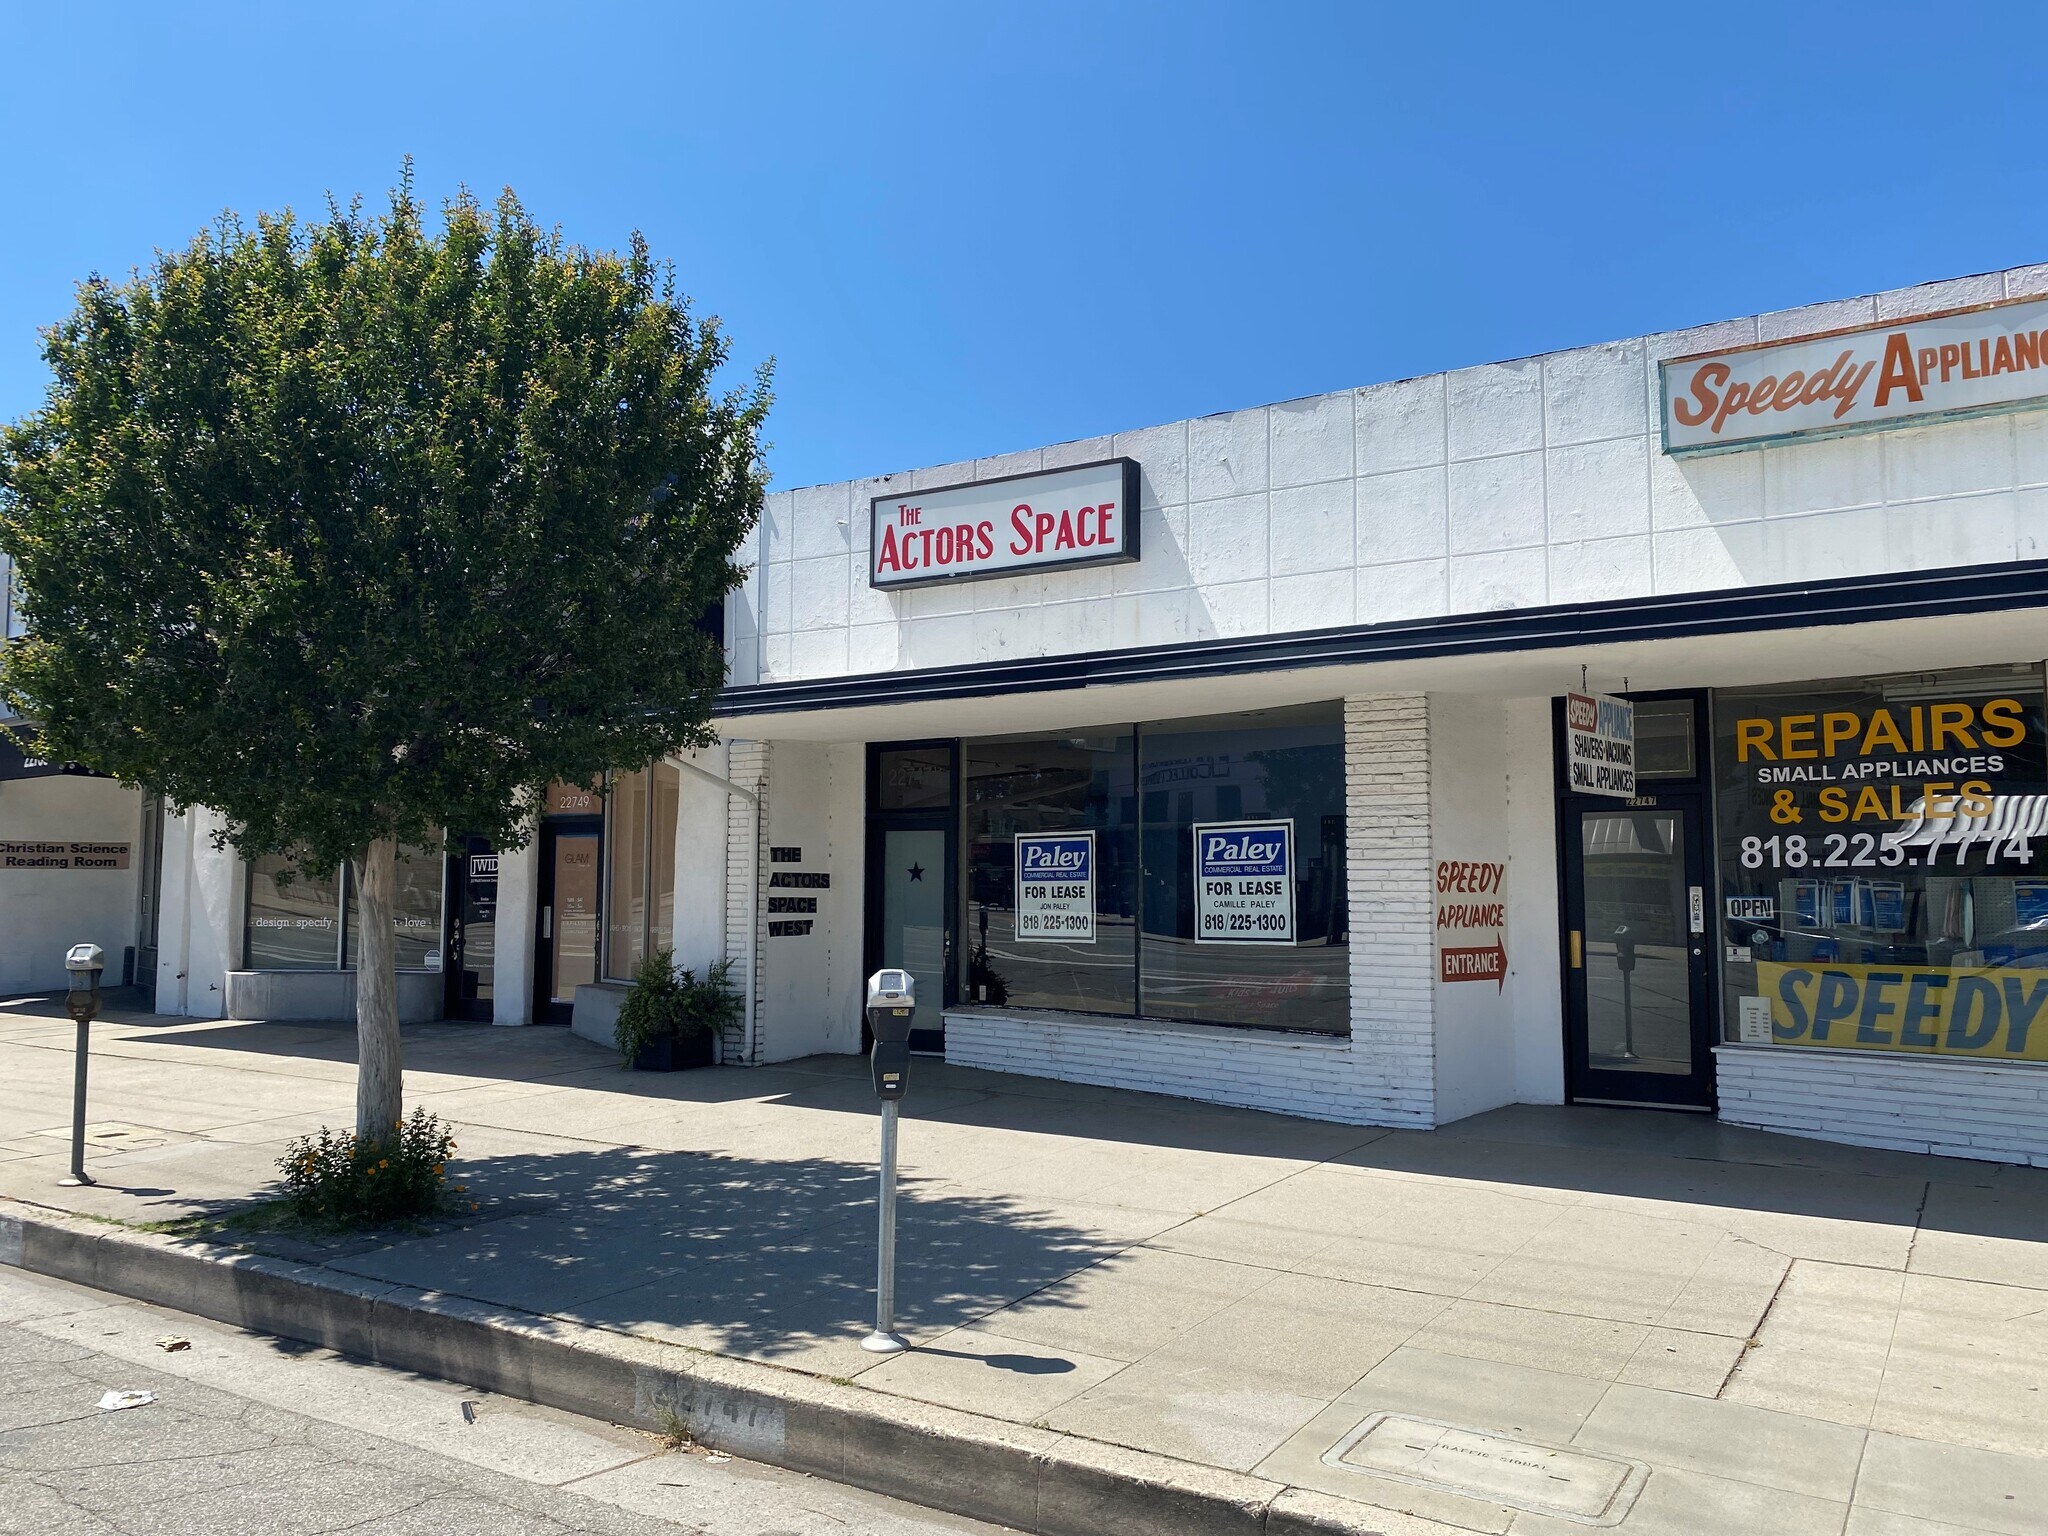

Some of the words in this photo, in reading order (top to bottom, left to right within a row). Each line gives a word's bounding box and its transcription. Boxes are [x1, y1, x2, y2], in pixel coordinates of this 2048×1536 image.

[1674, 350, 1877, 434] Speedy
[898, 504, 922, 527] THE
[877, 520, 993, 574] ACTORS
[1009, 503, 1115, 556] SPACE
[1570, 699, 1595, 728] SPEEDY
[1598, 700, 1633, 742] APPLIANCE
[1736, 698, 2027, 763] REPAIRS
[1573, 762, 1594, 788] SMALL
[1596, 765, 1634, 793] APPLIANCES
[1758, 765, 1836, 784] SMALL
[1841, 755, 2004, 780] APPLIANCES
[560, 795, 590, 809] 22749
[1627, 797, 1656, 806] 22747
[1769, 789, 1803, 824] &
[1818, 780, 1995, 823] SALES
[70, 843, 128, 854] Science
[770, 847, 801, 862] THE
[1205, 836, 1282, 863] Paley
[1740, 828, 2034, 869] 818.225.7774
[5, 856, 68, 869] Reading
[74, 856, 117, 867] Room
[1024, 845, 1087, 871] Paley
[1023, 871, 1054, 879] COMMERCIAL
[1204, 866, 1243, 874] COMMERCIAL
[1244, 865, 1260, 873] REAL
[1437, 861, 1504, 895] SPEEDY
[769, 872, 830, 888] ACTORS
[1206, 882, 1232, 896] FOR
[1238, 881, 1282, 896] LEASE
[1025, 886, 1046, 899] FOR
[1051, 886, 1086, 899] LEASE
[768, 897, 817, 913] SPACE
[1040, 903, 1052, 911] JON
[1213, 900, 1246, 909] CAMILLE
[1250, 900, 1276, 909] PALEY
[1730, 899, 1772, 918] OPEN
[256, 917, 290, 930] design
[296, 916, 333, 930] specify
[404, 917, 427, 928] love
[1022, 913, 1089, 931] 818/225-1300
[1204, 914, 1286, 932] 818/225-1300
[1437, 903, 1504, 931] APPLIANCE
[768, 920, 814, 938] WEST
[1445, 952, 1500, 976] ENTRANCE
[1772, 968, 2048, 1053] SPEEDY
